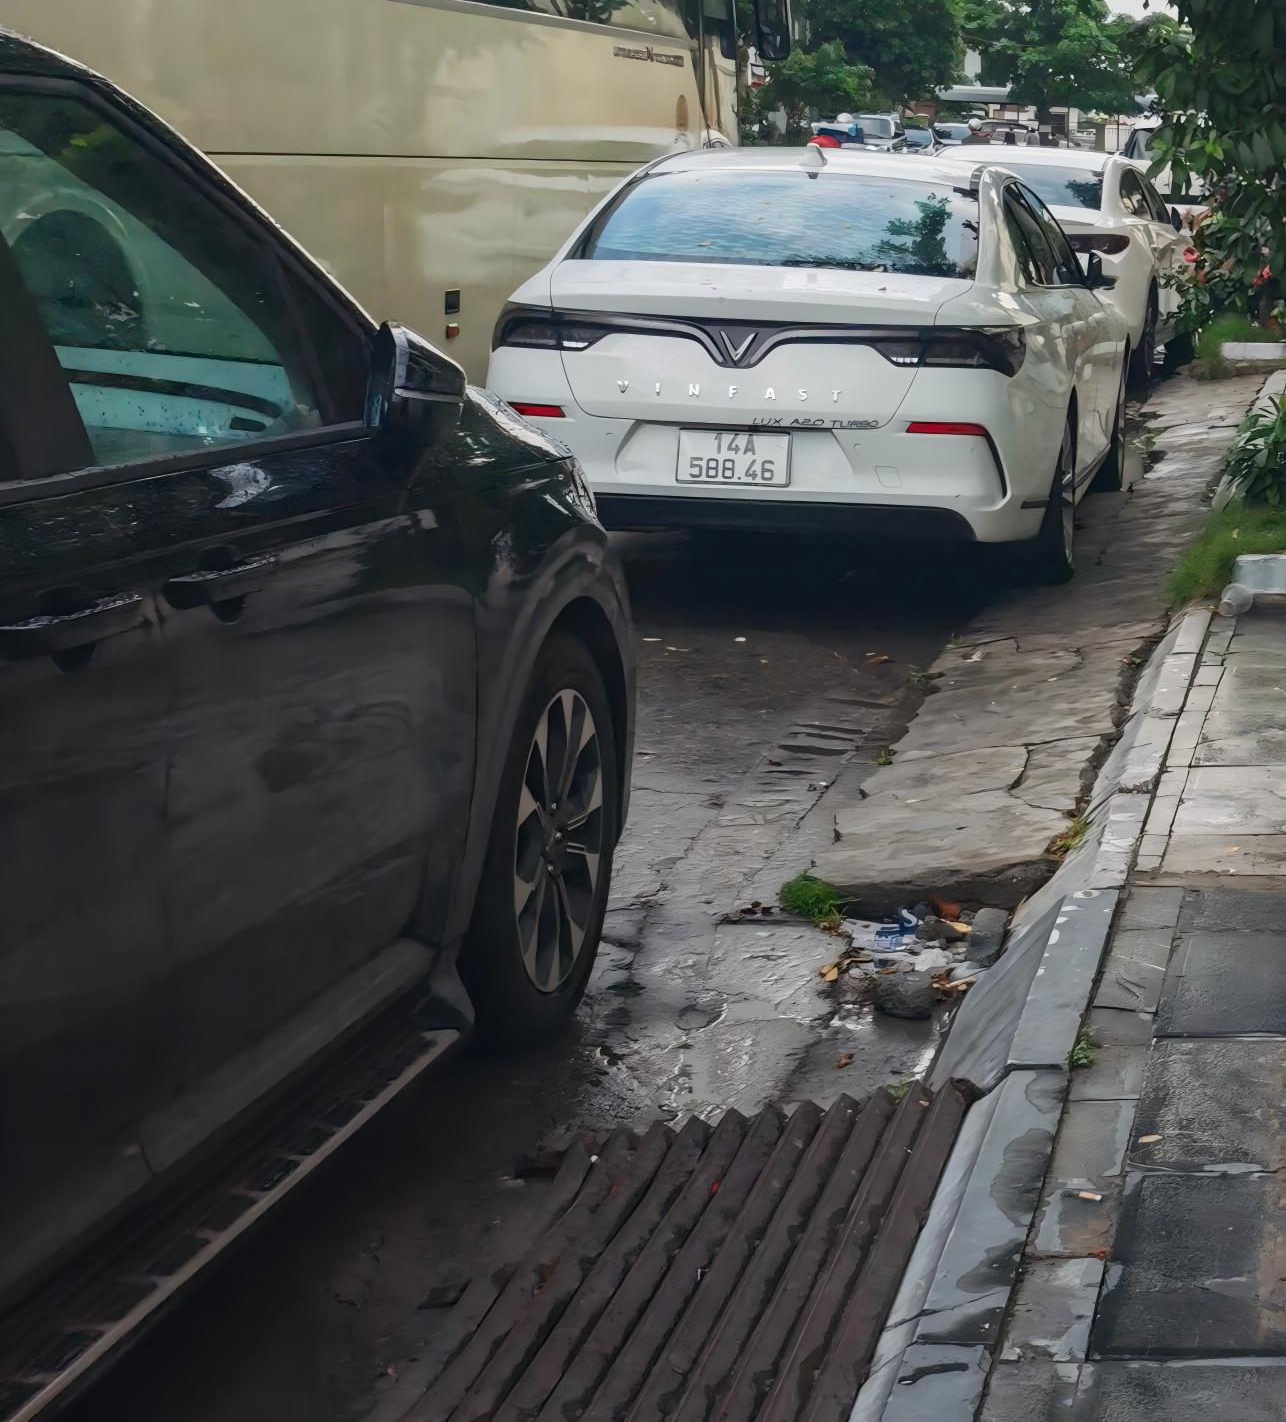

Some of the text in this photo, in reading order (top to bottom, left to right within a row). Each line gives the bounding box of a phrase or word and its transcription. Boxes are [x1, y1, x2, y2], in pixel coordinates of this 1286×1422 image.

[617, 380, 842, 402] VINFAST
[752, 417, 783, 426] LUX
[714, 433, 756, 455] 14A
[689, 457, 775, 481] 588.46
